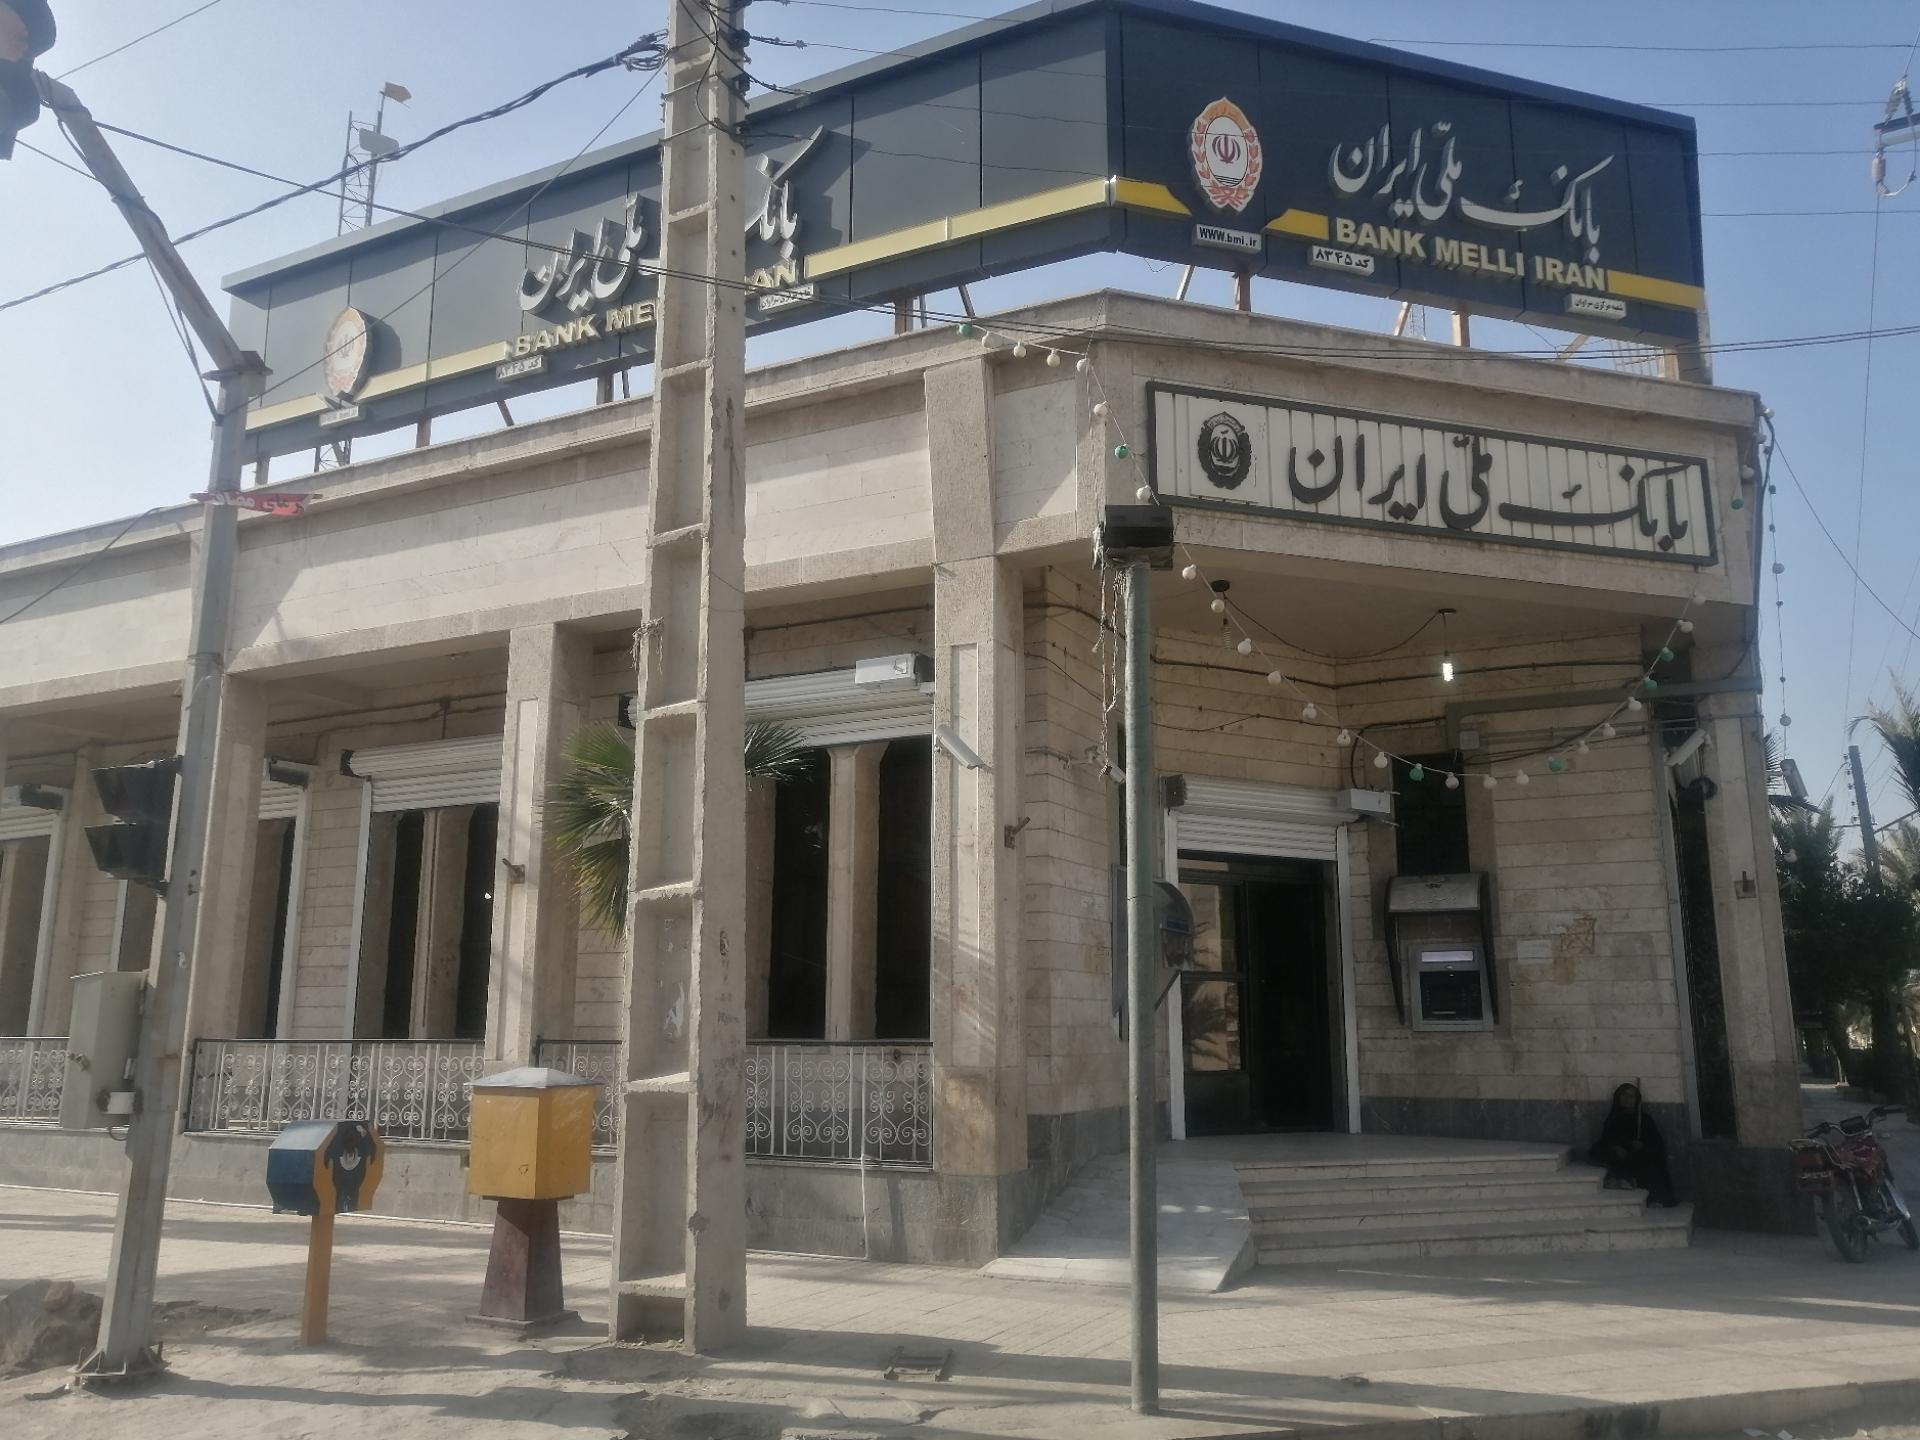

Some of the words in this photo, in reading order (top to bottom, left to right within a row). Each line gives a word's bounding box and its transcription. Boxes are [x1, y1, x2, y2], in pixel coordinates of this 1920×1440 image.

[1332, 122, 1422, 218] ایران
[1460, 154, 1615, 263] بانک
[1315, 249, 1353, 266] ۸۳۴۵
[1336, 216, 1427, 258] BANK
[1435, 237, 1526, 277] MELLI
[1534, 255, 1606, 292] IRAN
[1354, 258, 1371, 269] کد
[515, 313, 599, 356] BANK
[1289, 433, 1426, 521] ایران
[1500, 455, 1692, 551] بانک
